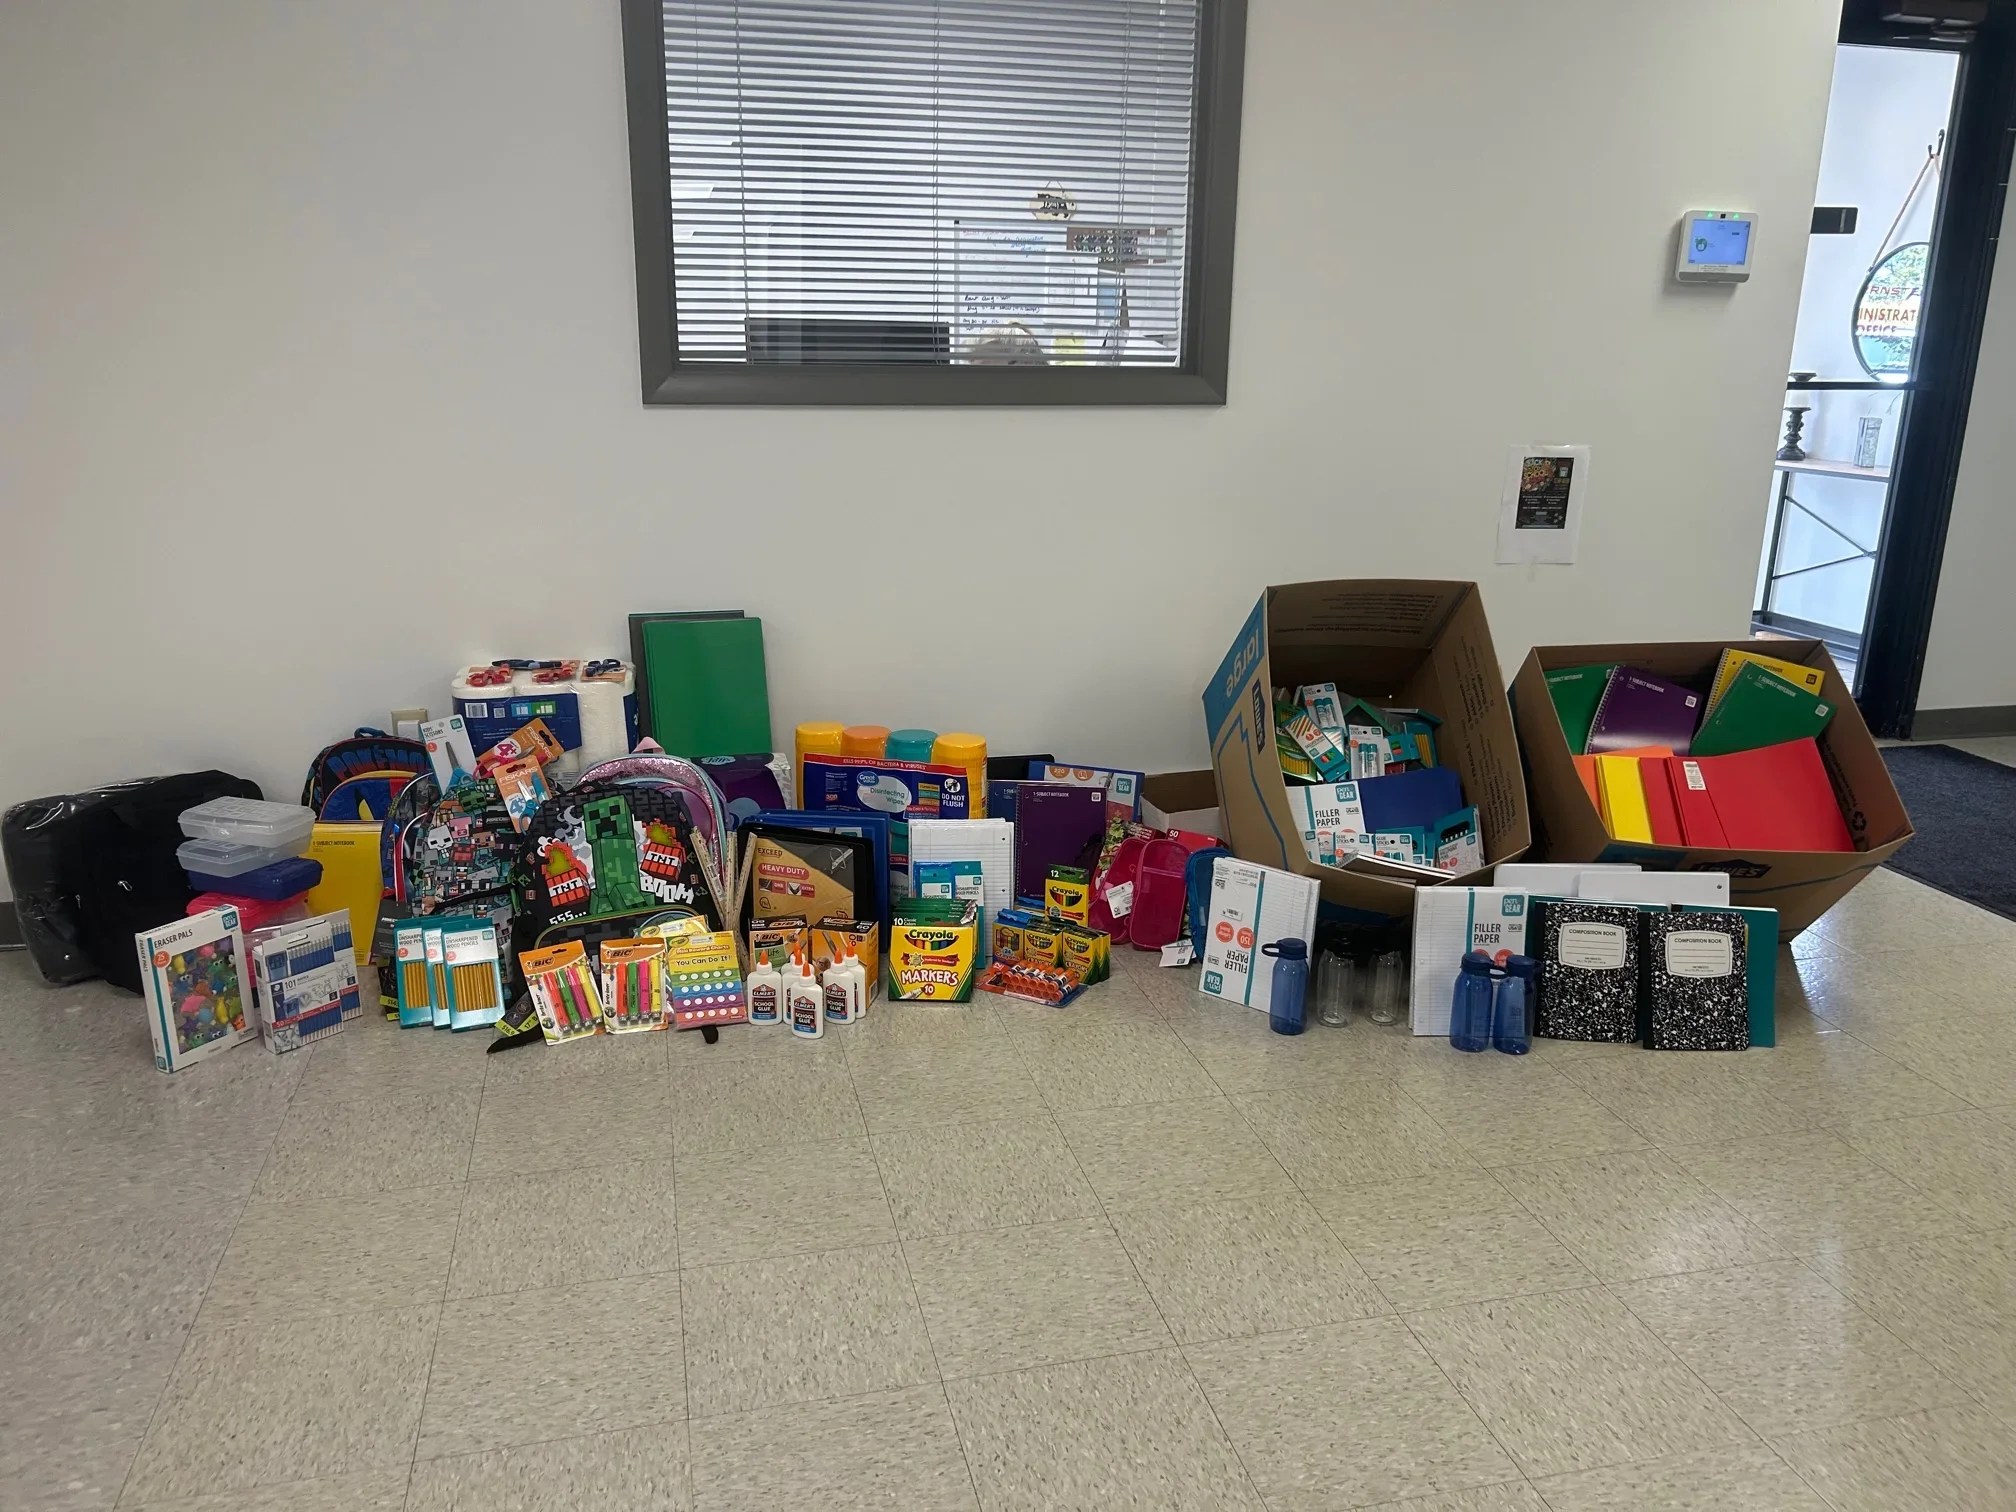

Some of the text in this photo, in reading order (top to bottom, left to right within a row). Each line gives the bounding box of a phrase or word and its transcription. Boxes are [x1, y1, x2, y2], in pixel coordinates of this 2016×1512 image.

[1226, 628, 1259, 698] large
[526, 726, 553, 758] FISKARS
[499, 766, 538, 782] FISKARS
[870, 788, 905, 798] Disinfecting
[1339, 791, 1354, 799] GEAR
[1315, 809, 1340, 818] FILLER
[1316, 818, 1341, 826] PAPER
[758, 848, 782, 856] EXCEED
[650, 853, 676, 864] TNT
[762, 864, 805, 875] HEAVY DUTY
[553, 880, 578, 893] TNT
[640, 876, 695, 904] BOOM
[1051, 886, 1080, 896] Crayola
[1474, 924, 1501, 932] FILLER
[153, 934, 178, 949] ERASER
[178, 929, 193, 940] PALS
[909, 929, 953, 940] Crayola
[1028, 933, 1051, 941] Crayola
[1474, 934, 1500, 943] PAPER
[446, 936, 478, 944] UNSHARPENED
[1066, 936, 1088, 946] Crayola
[1240, 936, 1250, 945] 150
[1227, 950, 1249, 963] PAPER
[533, 958, 553, 967] BIC
[1224, 960, 1248, 974] FILLER
[1066, 962, 1088, 974] CRAYONS
[901, 970, 958, 986] MARKERS
[285, 979, 296, 989] 101
